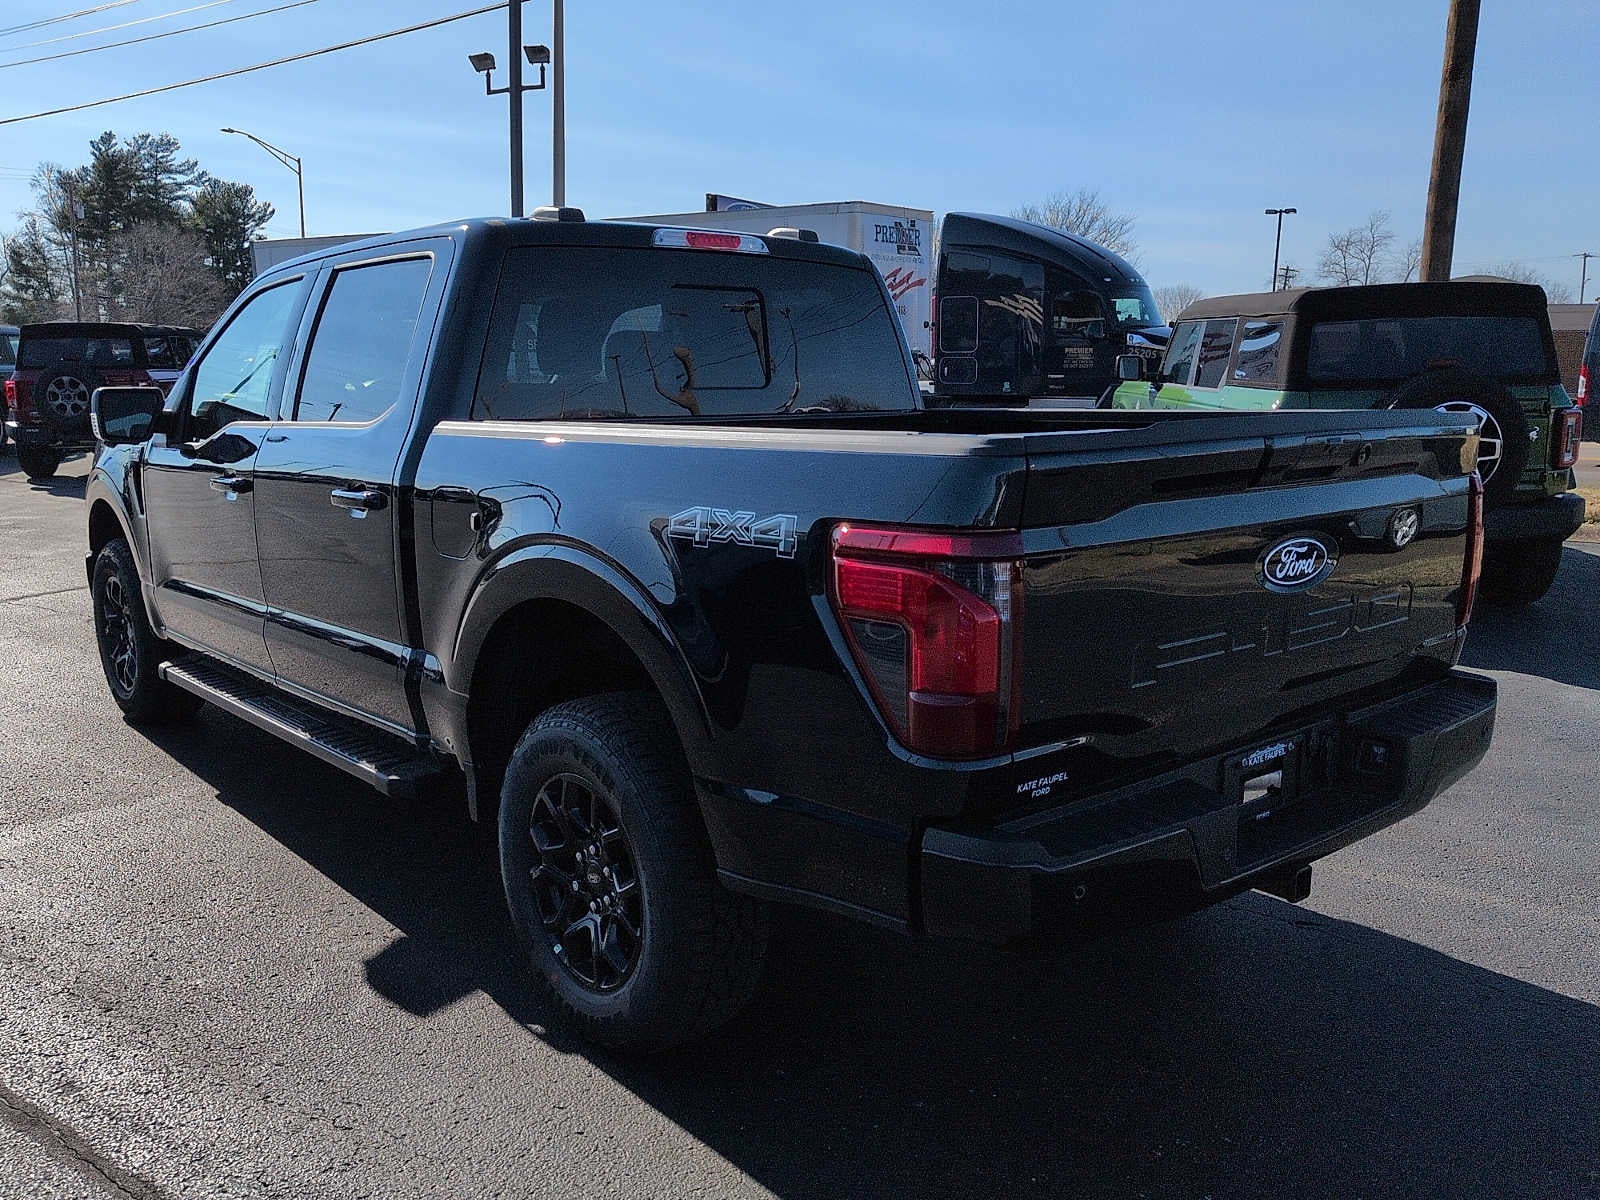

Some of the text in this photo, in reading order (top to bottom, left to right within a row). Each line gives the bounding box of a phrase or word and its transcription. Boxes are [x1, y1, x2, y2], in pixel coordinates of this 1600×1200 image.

[1276, 545, 1318, 578] Ford
[1249, 748, 1287, 767] KATE FAUPEL
[1017, 771, 1069, 794] KATE FAUPEL
[1031, 786, 1051, 798] FORD
